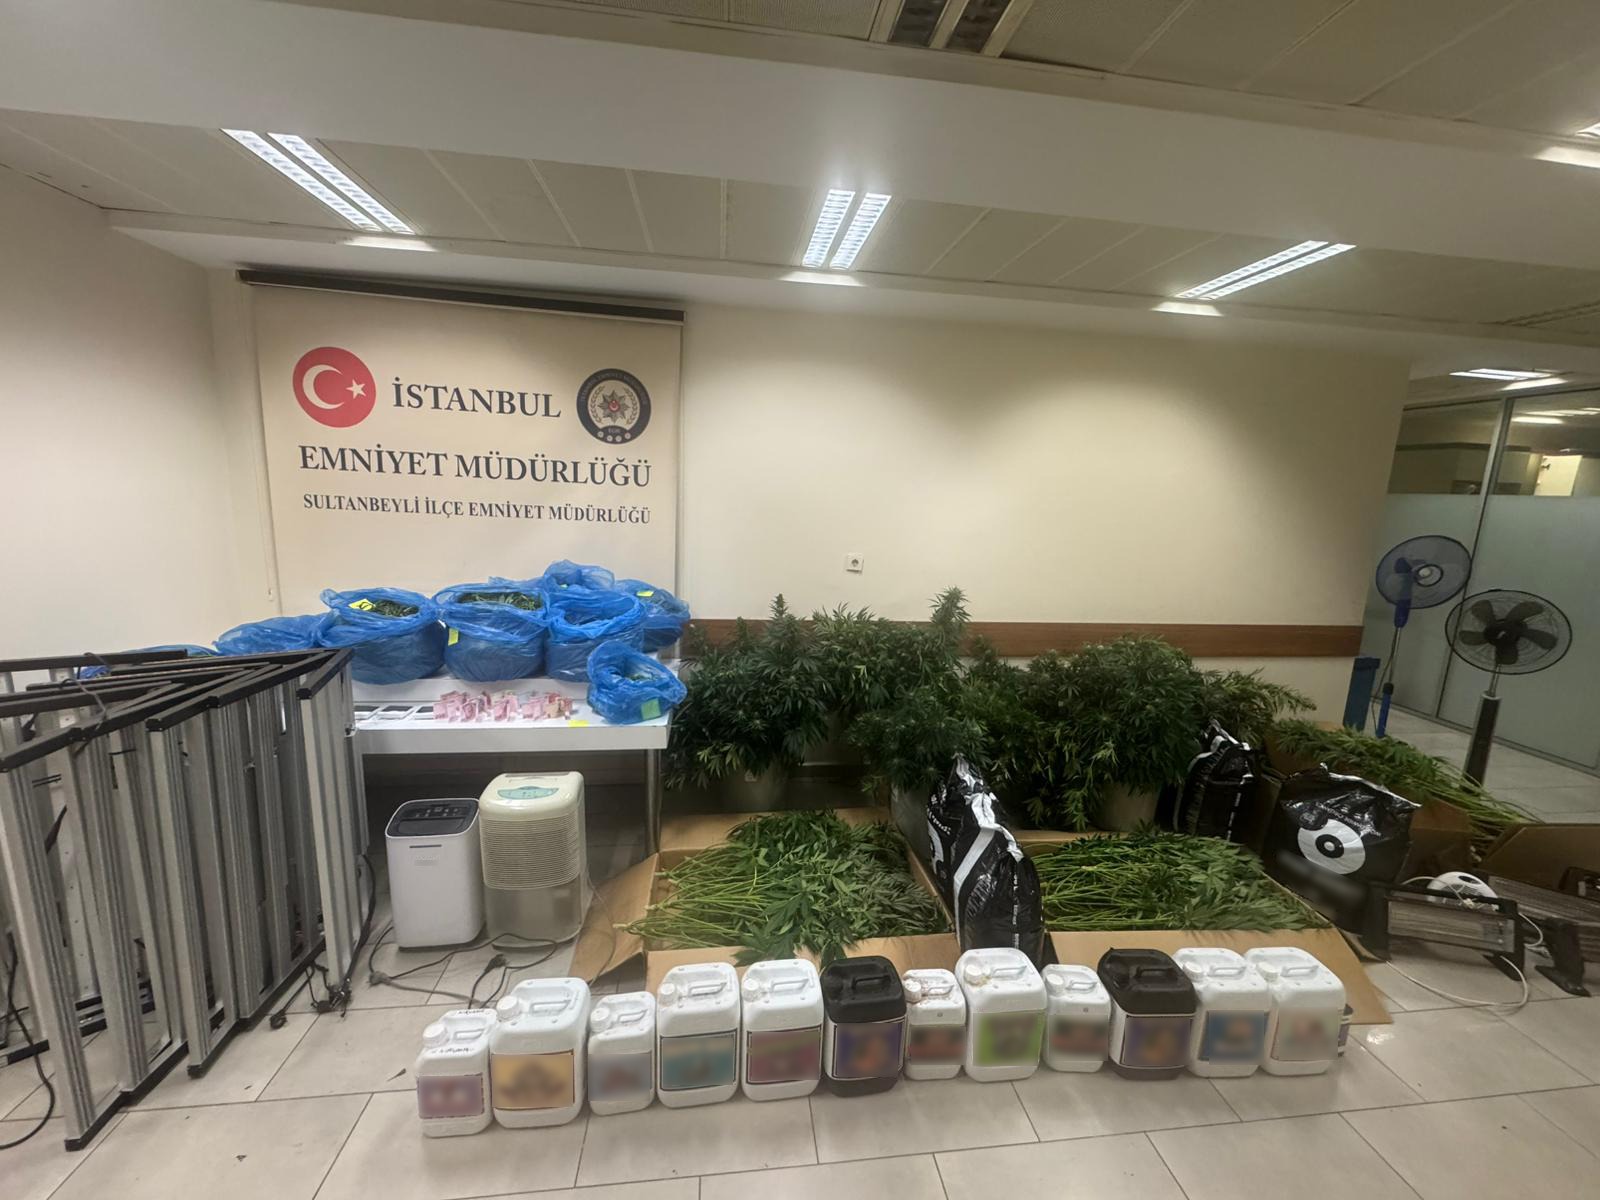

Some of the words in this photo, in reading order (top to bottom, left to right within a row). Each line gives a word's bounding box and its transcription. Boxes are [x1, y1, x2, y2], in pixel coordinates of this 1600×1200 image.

[392, 376, 561, 418] İSTANBUL
[298, 443, 448, 477] EMNİYET
[454, 450, 652, 488] MÜDÜRLÜĞÜ
[303, 494, 420, 514] SULTANBEYLİ
[425, 496, 464, 518] İLÇE
[468, 500, 545, 520] EMNİYET
[549, 503, 651, 525] MÜDÜRLÜĞÜ
